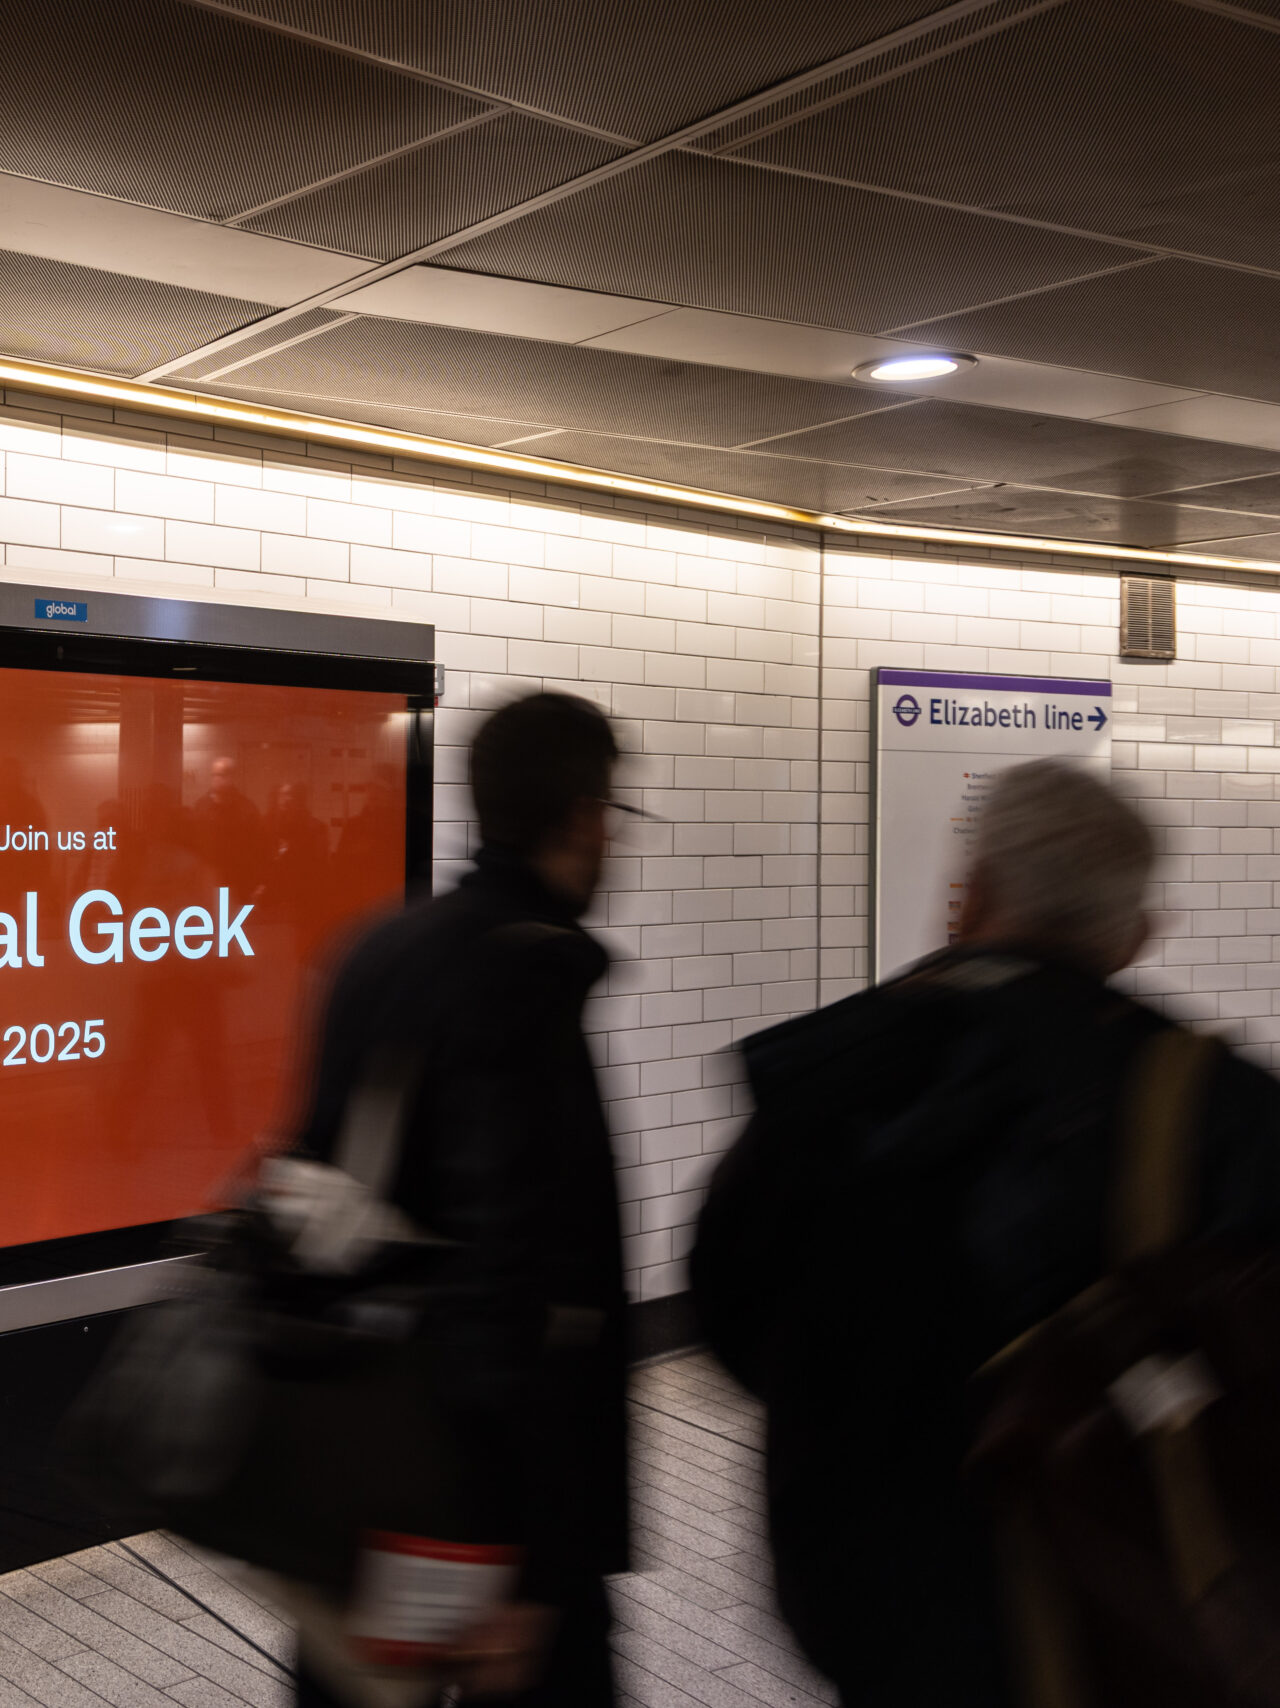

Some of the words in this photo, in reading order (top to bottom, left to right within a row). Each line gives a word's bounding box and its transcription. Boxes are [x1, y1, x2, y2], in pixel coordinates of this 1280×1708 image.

[46, 602, 76, 618] global
[930, 698, 1036, 729] Elizabeth
[1045, 704, 1083, 731] line
[57, 831, 86, 851] us
[93, 826, 117, 851] at
[68, 886, 255, 965] Geek
[2, 1019, 106, 1067] 2025
